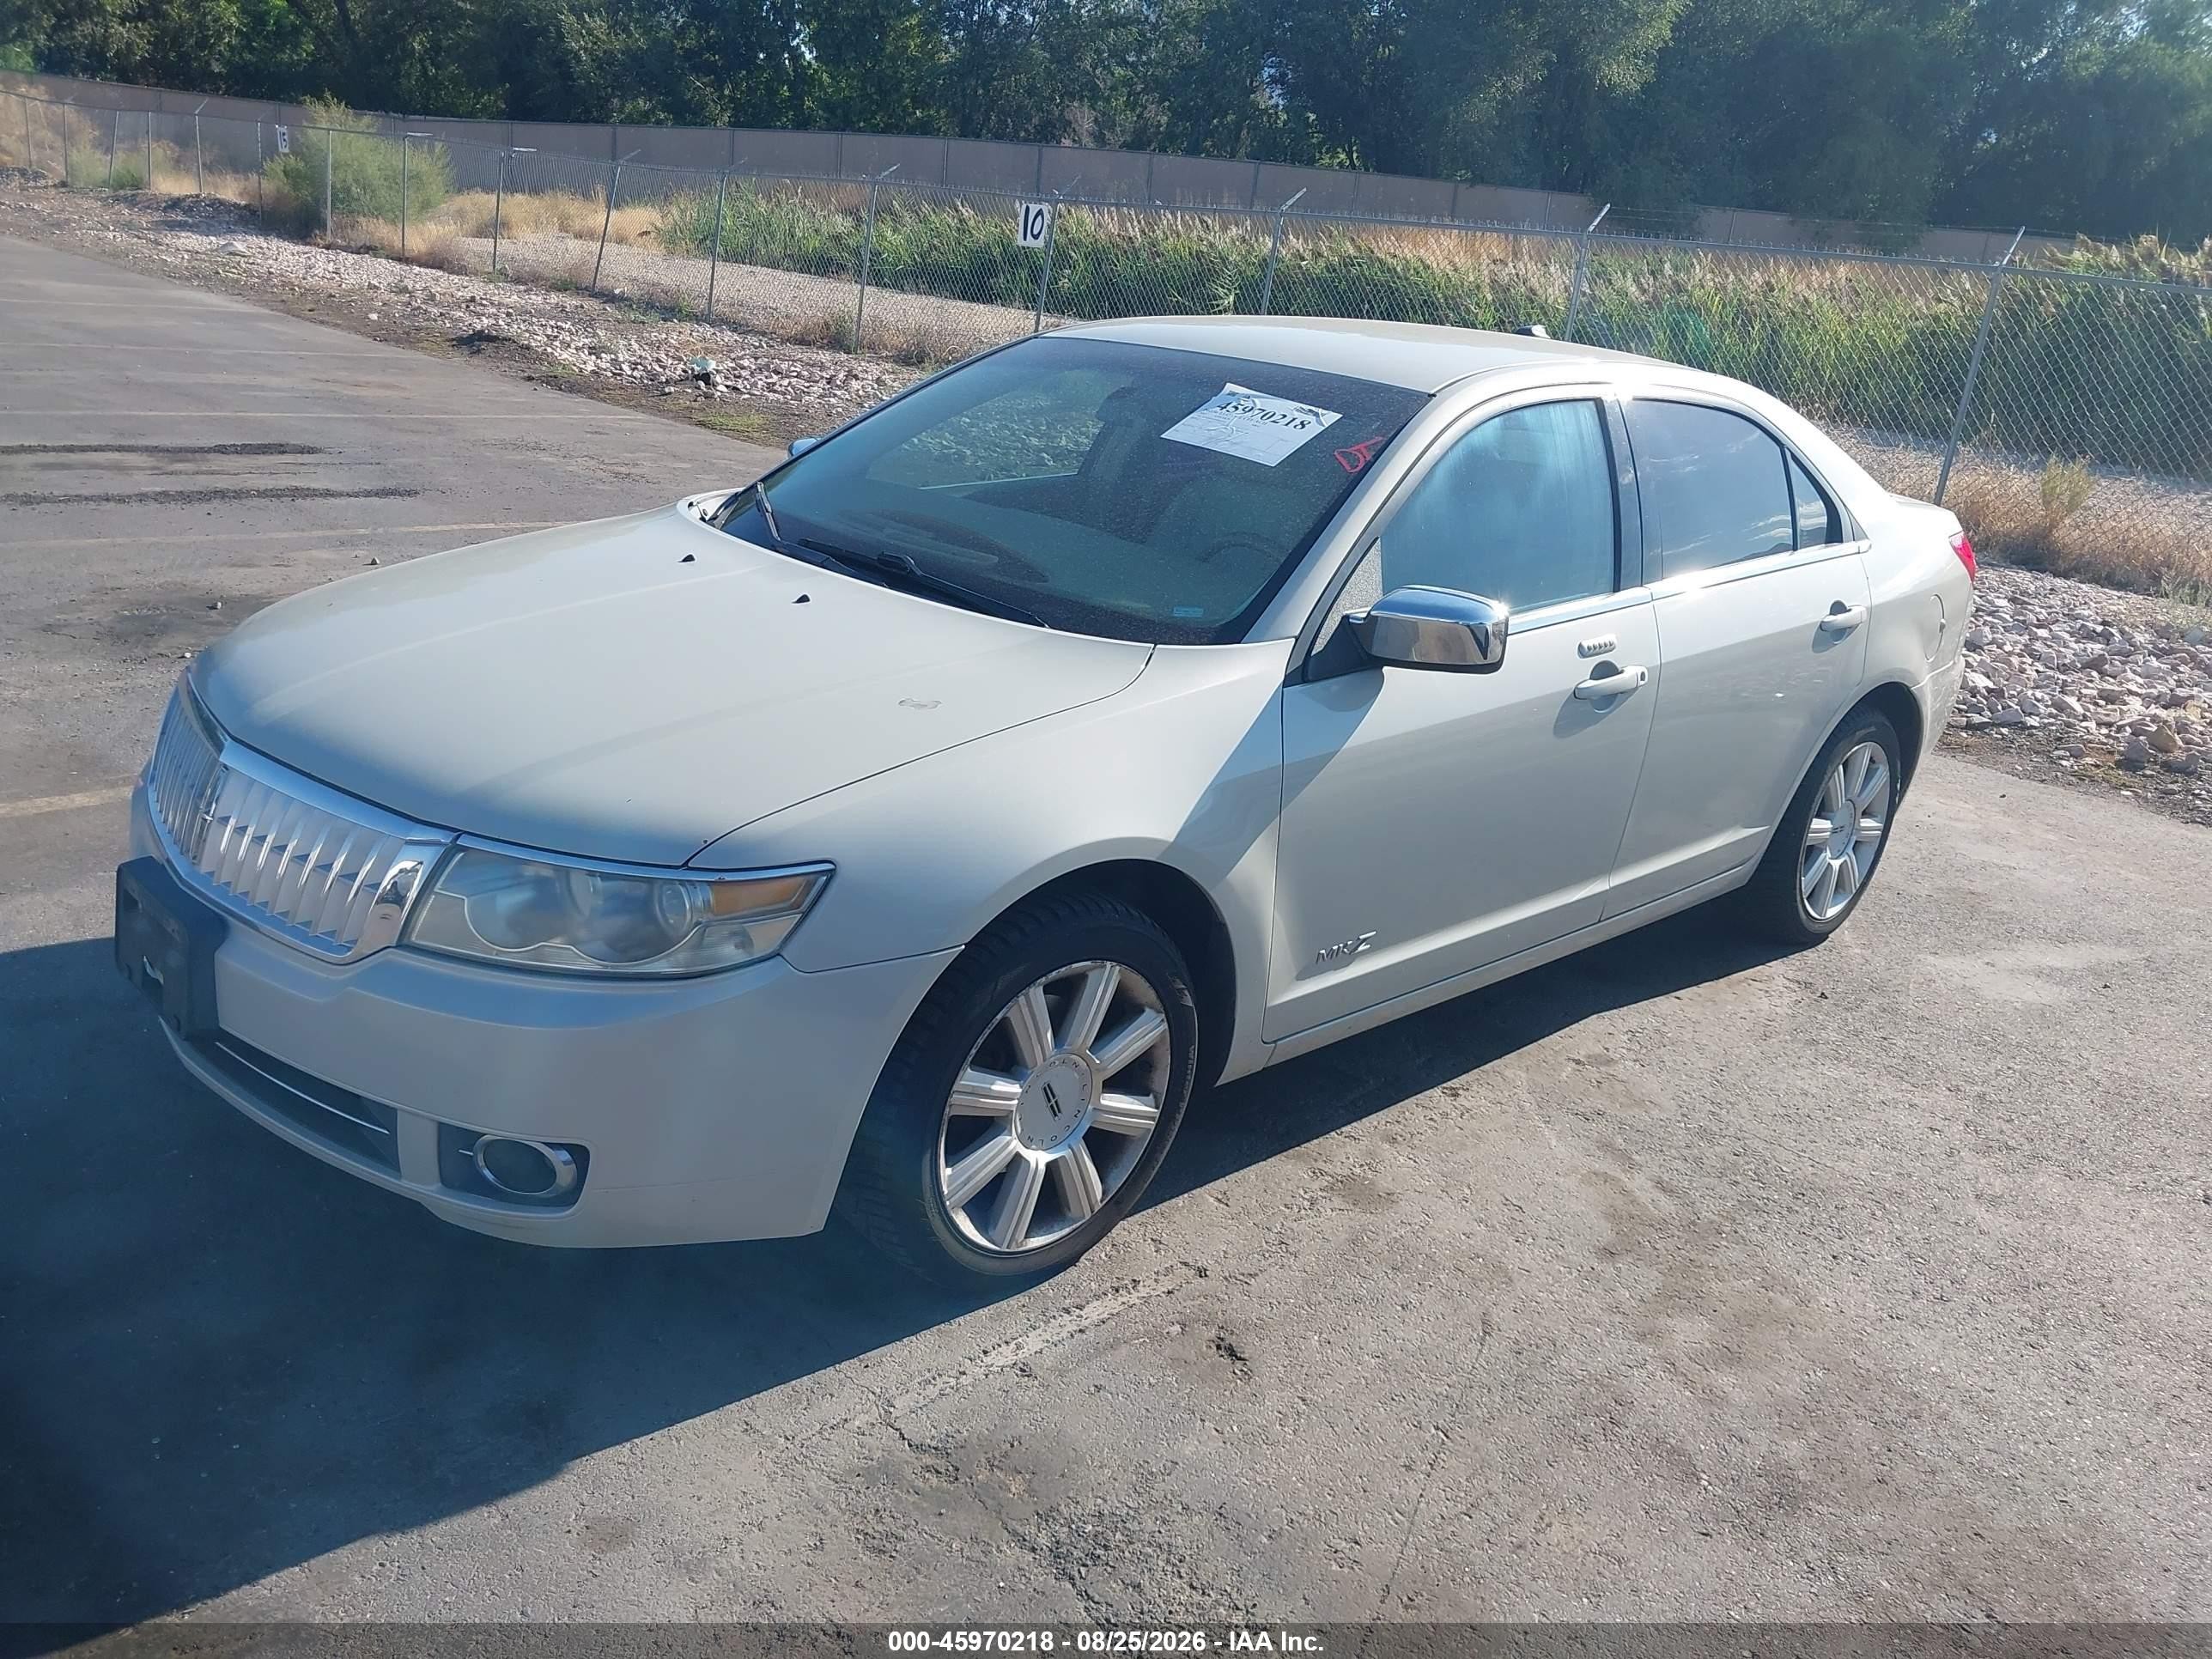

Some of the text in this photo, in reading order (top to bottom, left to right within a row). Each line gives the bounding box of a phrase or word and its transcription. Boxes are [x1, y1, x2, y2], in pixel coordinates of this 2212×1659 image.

[1023, 204, 1045, 241] 10
[1216, 400, 1312, 430] 45970218
[1315, 931, 1377, 964] MKZ
